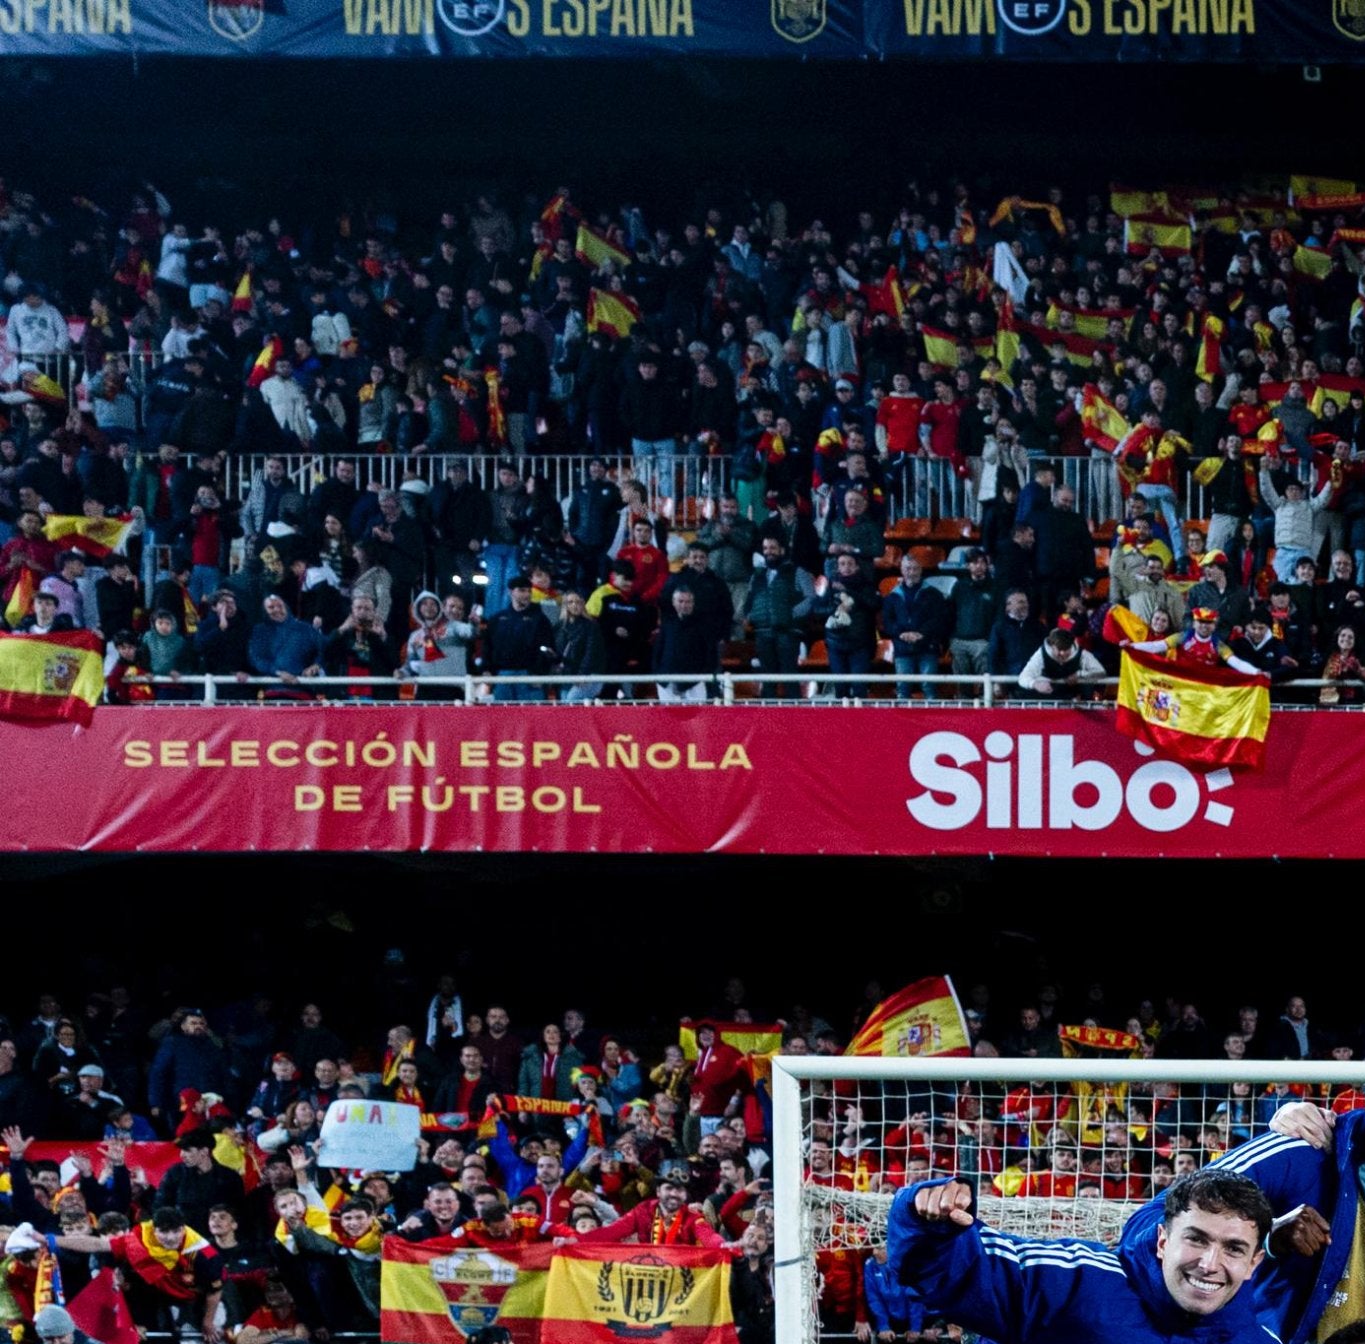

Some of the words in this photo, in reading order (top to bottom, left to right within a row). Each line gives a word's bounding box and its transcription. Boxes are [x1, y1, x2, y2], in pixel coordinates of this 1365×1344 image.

[125, 732, 436, 768] SELECCIÓN
[460, 734, 752, 769] ESPAÑOLA
[295, 785, 361, 812] DE
[386, 777, 602, 813] FÚTBOL
